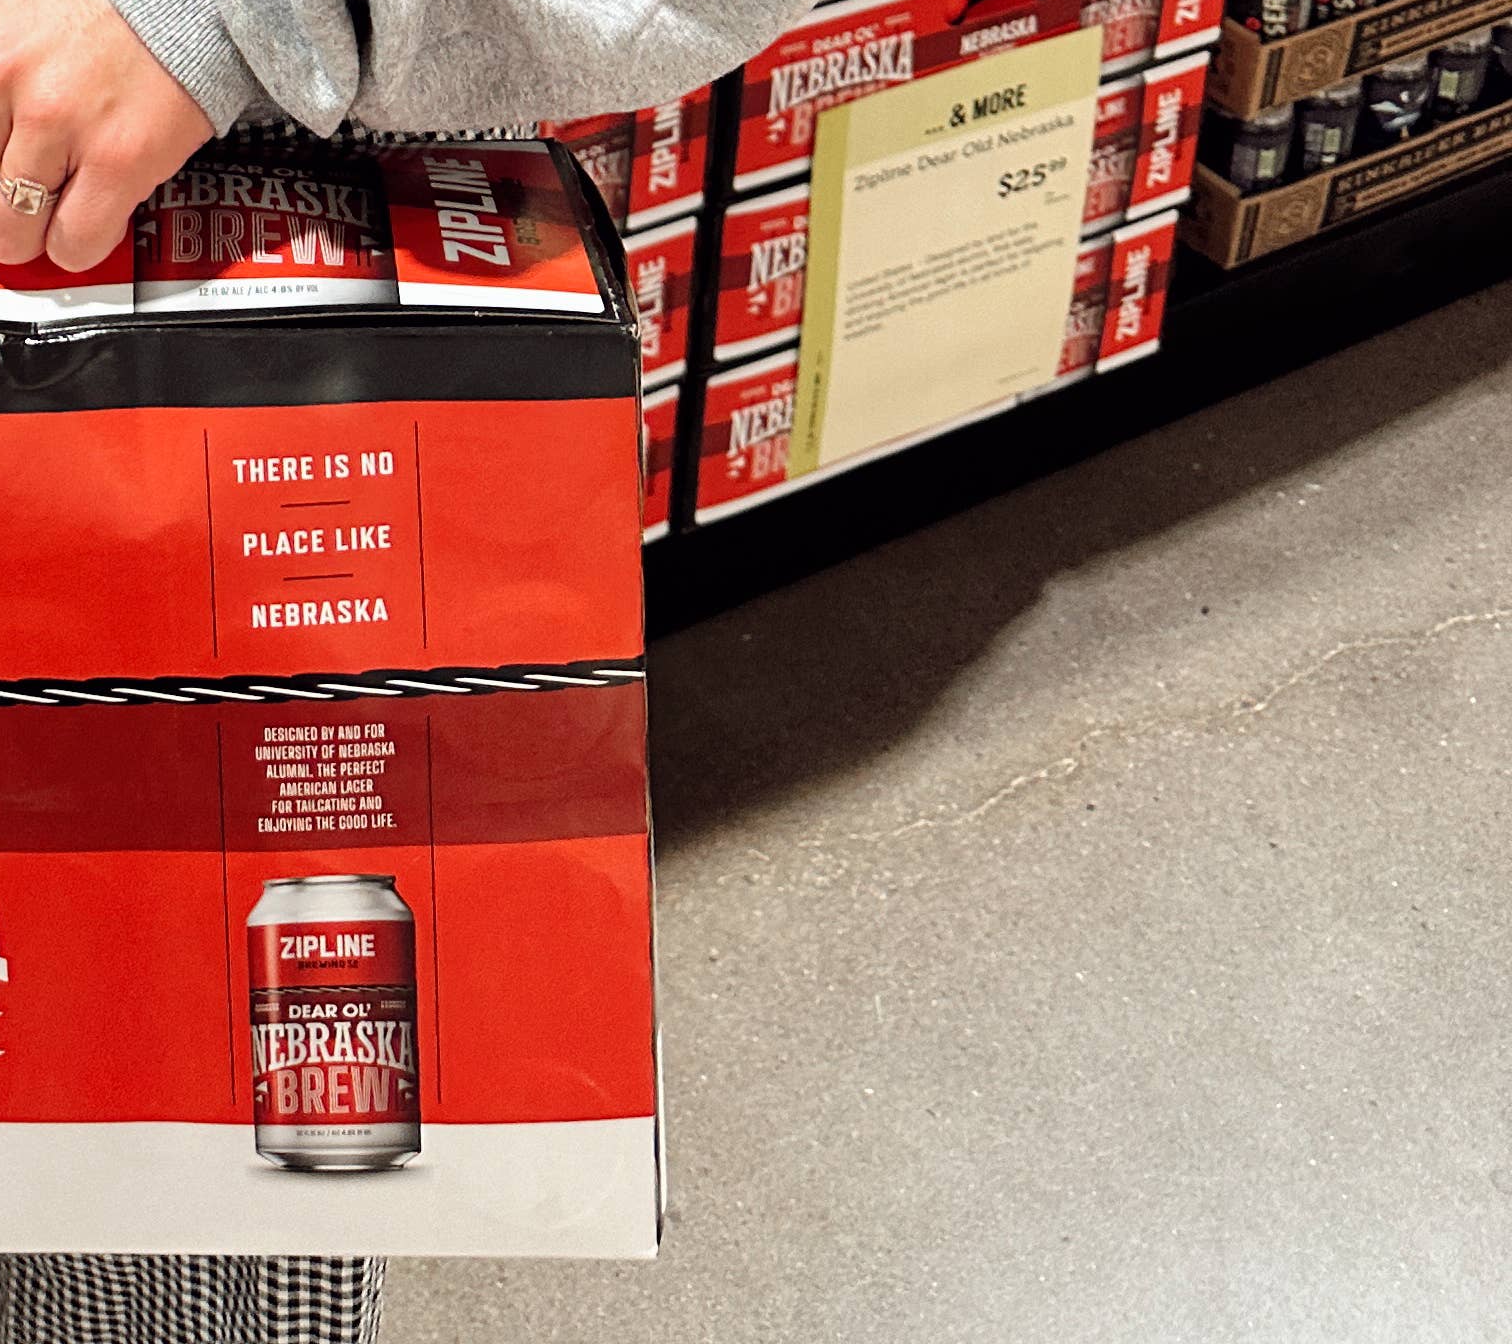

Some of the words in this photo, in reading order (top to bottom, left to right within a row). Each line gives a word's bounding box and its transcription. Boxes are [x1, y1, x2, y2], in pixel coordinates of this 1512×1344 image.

[767, 30, 916, 118] NEBRASKA
[949, 103, 966, 128] &
[973, 83, 1028, 120] MORE
[961, 136, 995, 159] Old
[997, 114, 1075, 149] Nebraska
[1147, 88, 1182, 189] ZIPLINE
[424, 156, 512, 267] ZIPLINE
[171, 210, 346, 267] BREW
[1116, 245, 1151, 342] ZIPLINE
[232, 455, 314, 483] THERE
[325, 454, 349, 479] IS
[361, 451, 394, 477] NO
[243, 529, 325, 557] PLACE
[335, 525, 392, 552] LIKE
[251, 598, 388, 629] NEBRASKA
[264, 727, 318, 742] DESIGNED
[321, 726, 334, 741] BY
[338, 725, 361, 740] AND
[364, 723, 385, 738] FOR
[255, 745, 318, 761] UNIVERSITY
[321, 744, 335, 759] OF
[338, 741, 395, 759] NEBRASKA
[317, 762, 337, 777] THE
[340, 760, 386, 776] PERFECT
[279, 781, 337, 797] AMERICAN
[340, 778, 374, 794] LAGER
[271, 799, 292, 814] FOR
[295, 797, 356, 813] TAILGATING
[359, 795, 382, 811] AND
[258, 816, 313, 832] ENJOYING
[315, 815, 336, 831] THE
[338, 814, 368, 830] GOOD
[371, 813, 397, 829] LIFE.
[279, 933, 376, 960] ZIPLINE
[288, 1003, 338, 1020] DEAR
[251, 1020, 417, 1078] NEBRASKA
[275, 1065, 390, 1114] BREW
